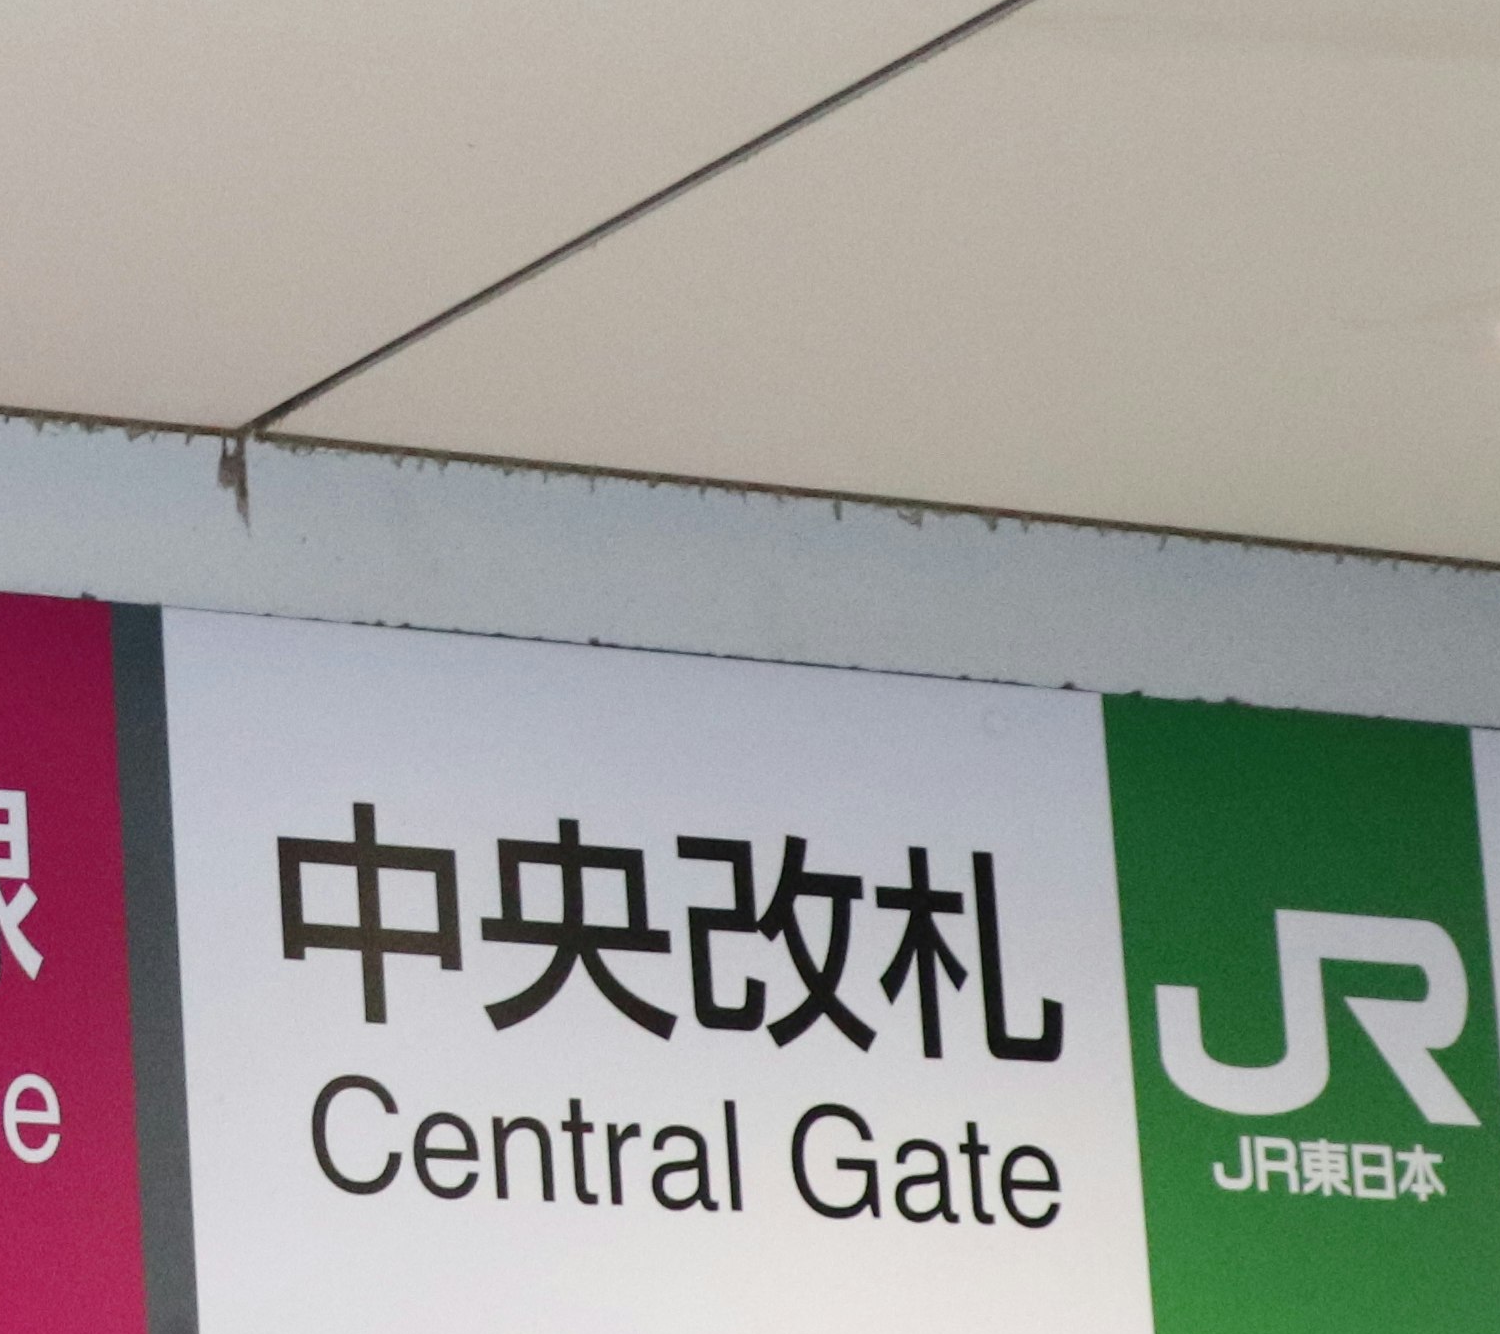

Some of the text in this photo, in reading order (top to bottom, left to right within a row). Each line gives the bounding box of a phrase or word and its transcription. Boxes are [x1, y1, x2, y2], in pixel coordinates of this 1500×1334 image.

[274, 801, 1065, 1064] 中央改札
[1154, 908, 1484, 1128] JR
[309, 1073, 1063, 1231] Central Gate
[1211, 1133, 1449, 1205] JR東日本
